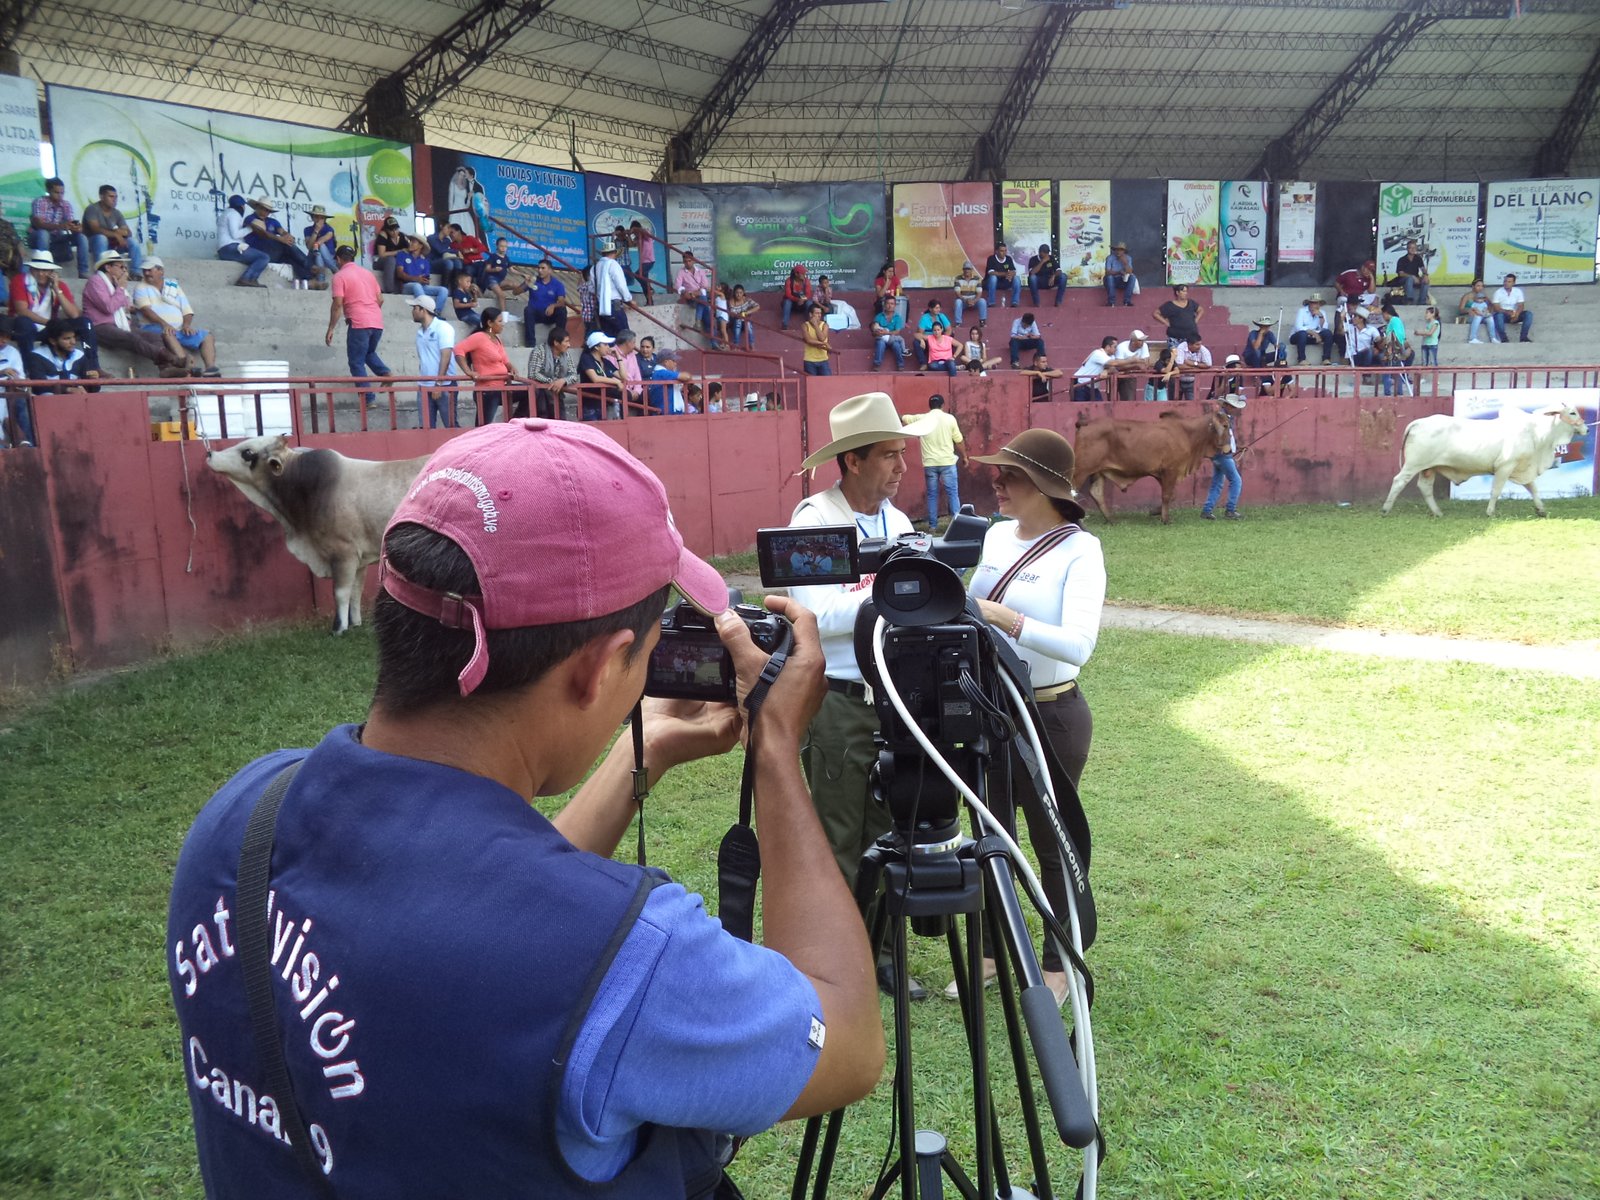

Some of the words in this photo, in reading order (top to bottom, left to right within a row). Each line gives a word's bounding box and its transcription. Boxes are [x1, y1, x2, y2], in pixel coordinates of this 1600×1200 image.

[170, 161, 312, 201] CAMARA
[497, 164, 532, 182] NOVIAS
[534, 170, 541, 183] Y
[543, 172, 577, 189] EVENTOS
[1013, 180, 1040, 188] TALLER
[171, 190, 182, 199] DE
[594, 183, 656, 209] AGÜITA
[1003, 189, 1051, 208] RK
[1413, 195, 1476, 203] ELECTROMUEBLES
[1494, 194, 1525, 208] DEL
[1532, 191, 1593, 206] LLANO
[363, 211, 386, 221] Tame
[175, 227, 217, 240] Apoya
[1042, 792, 1085, 894] Panasonic
[310, 1123, 334, 1176] 9
